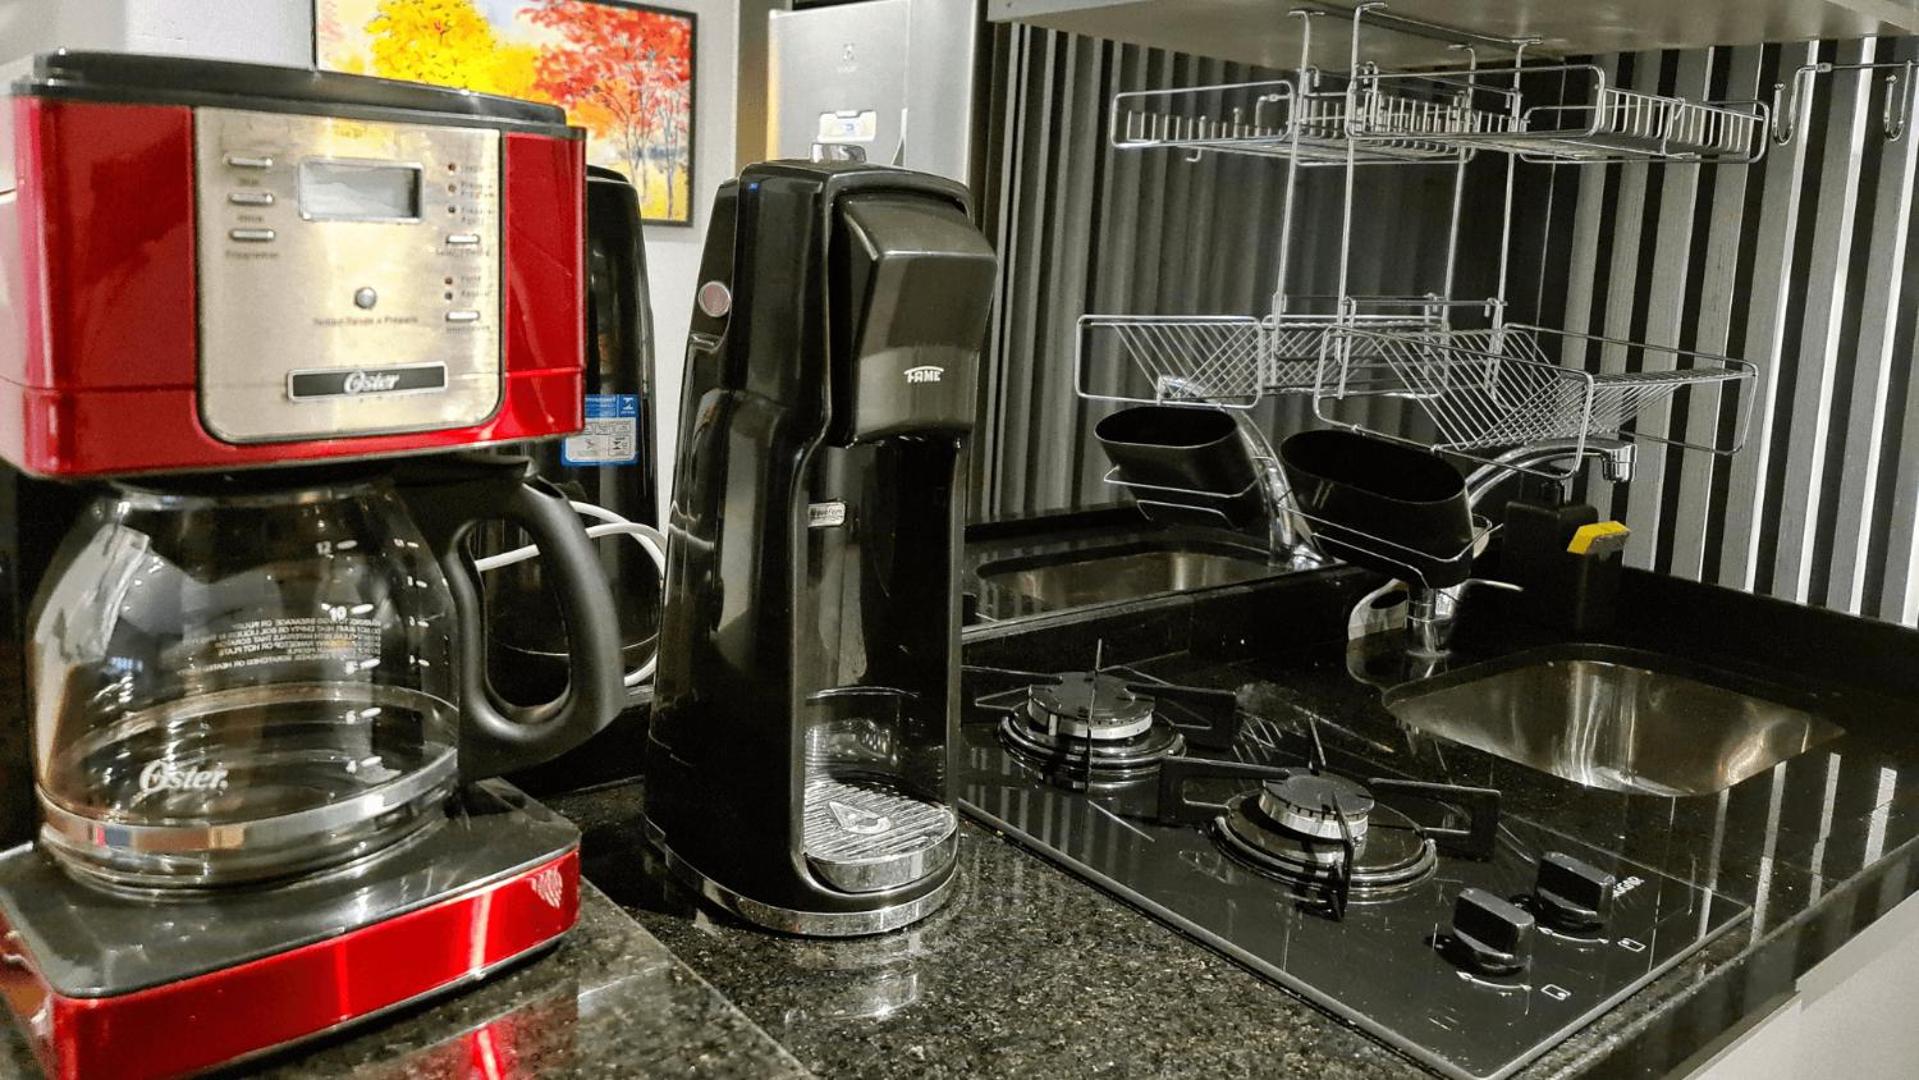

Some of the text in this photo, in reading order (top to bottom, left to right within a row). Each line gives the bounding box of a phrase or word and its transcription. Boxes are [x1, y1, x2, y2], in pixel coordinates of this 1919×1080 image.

[344, 369, 400, 395] Oster
[904, 366, 944, 383] FAME
[330, 605, 347, 621] 10
[133, 760, 229, 804] Oster
